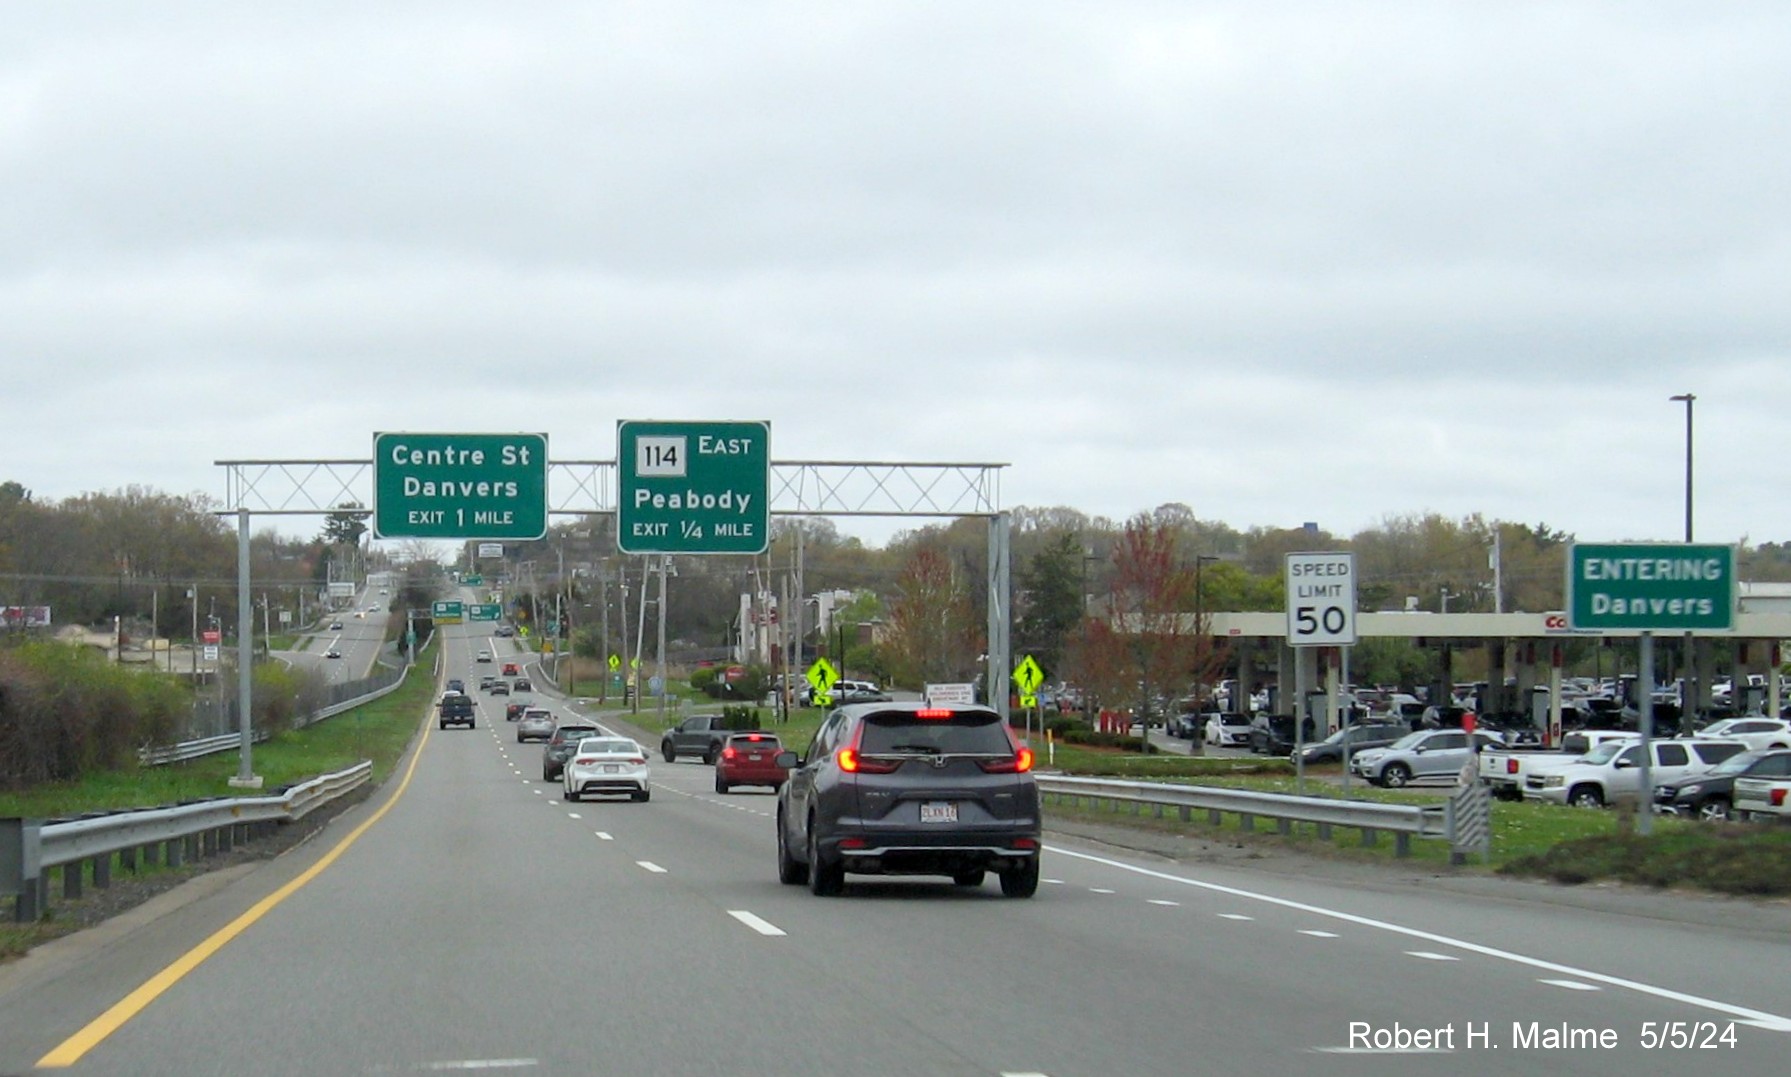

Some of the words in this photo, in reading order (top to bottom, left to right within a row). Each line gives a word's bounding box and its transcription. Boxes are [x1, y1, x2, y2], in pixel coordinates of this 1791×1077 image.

[392, 445, 485, 466] Centre
[502, 445, 530, 466] St
[645, 445, 678, 467] 114
[699, 436, 752, 454] EAST
[405, 477, 518, 497] Danvers
[636, 489, 751, 513] Peabody
[409, 511, 445, 525] EXIT
[456, 509, 464, 527] 1
[475, 511, 514, 525] MILE
[634, 523, 669, 536] EXIT
[715, 524, 753, 537] MILE
[1292, 563, 1348, 576] SPEED
[1584, 559, 1721, 580] ENTERING
[1299, 585, 1342, 598] LIMIT
[1592, 593, 1713, 615] Danvers
[1297, 606, 1345, 635] 50
